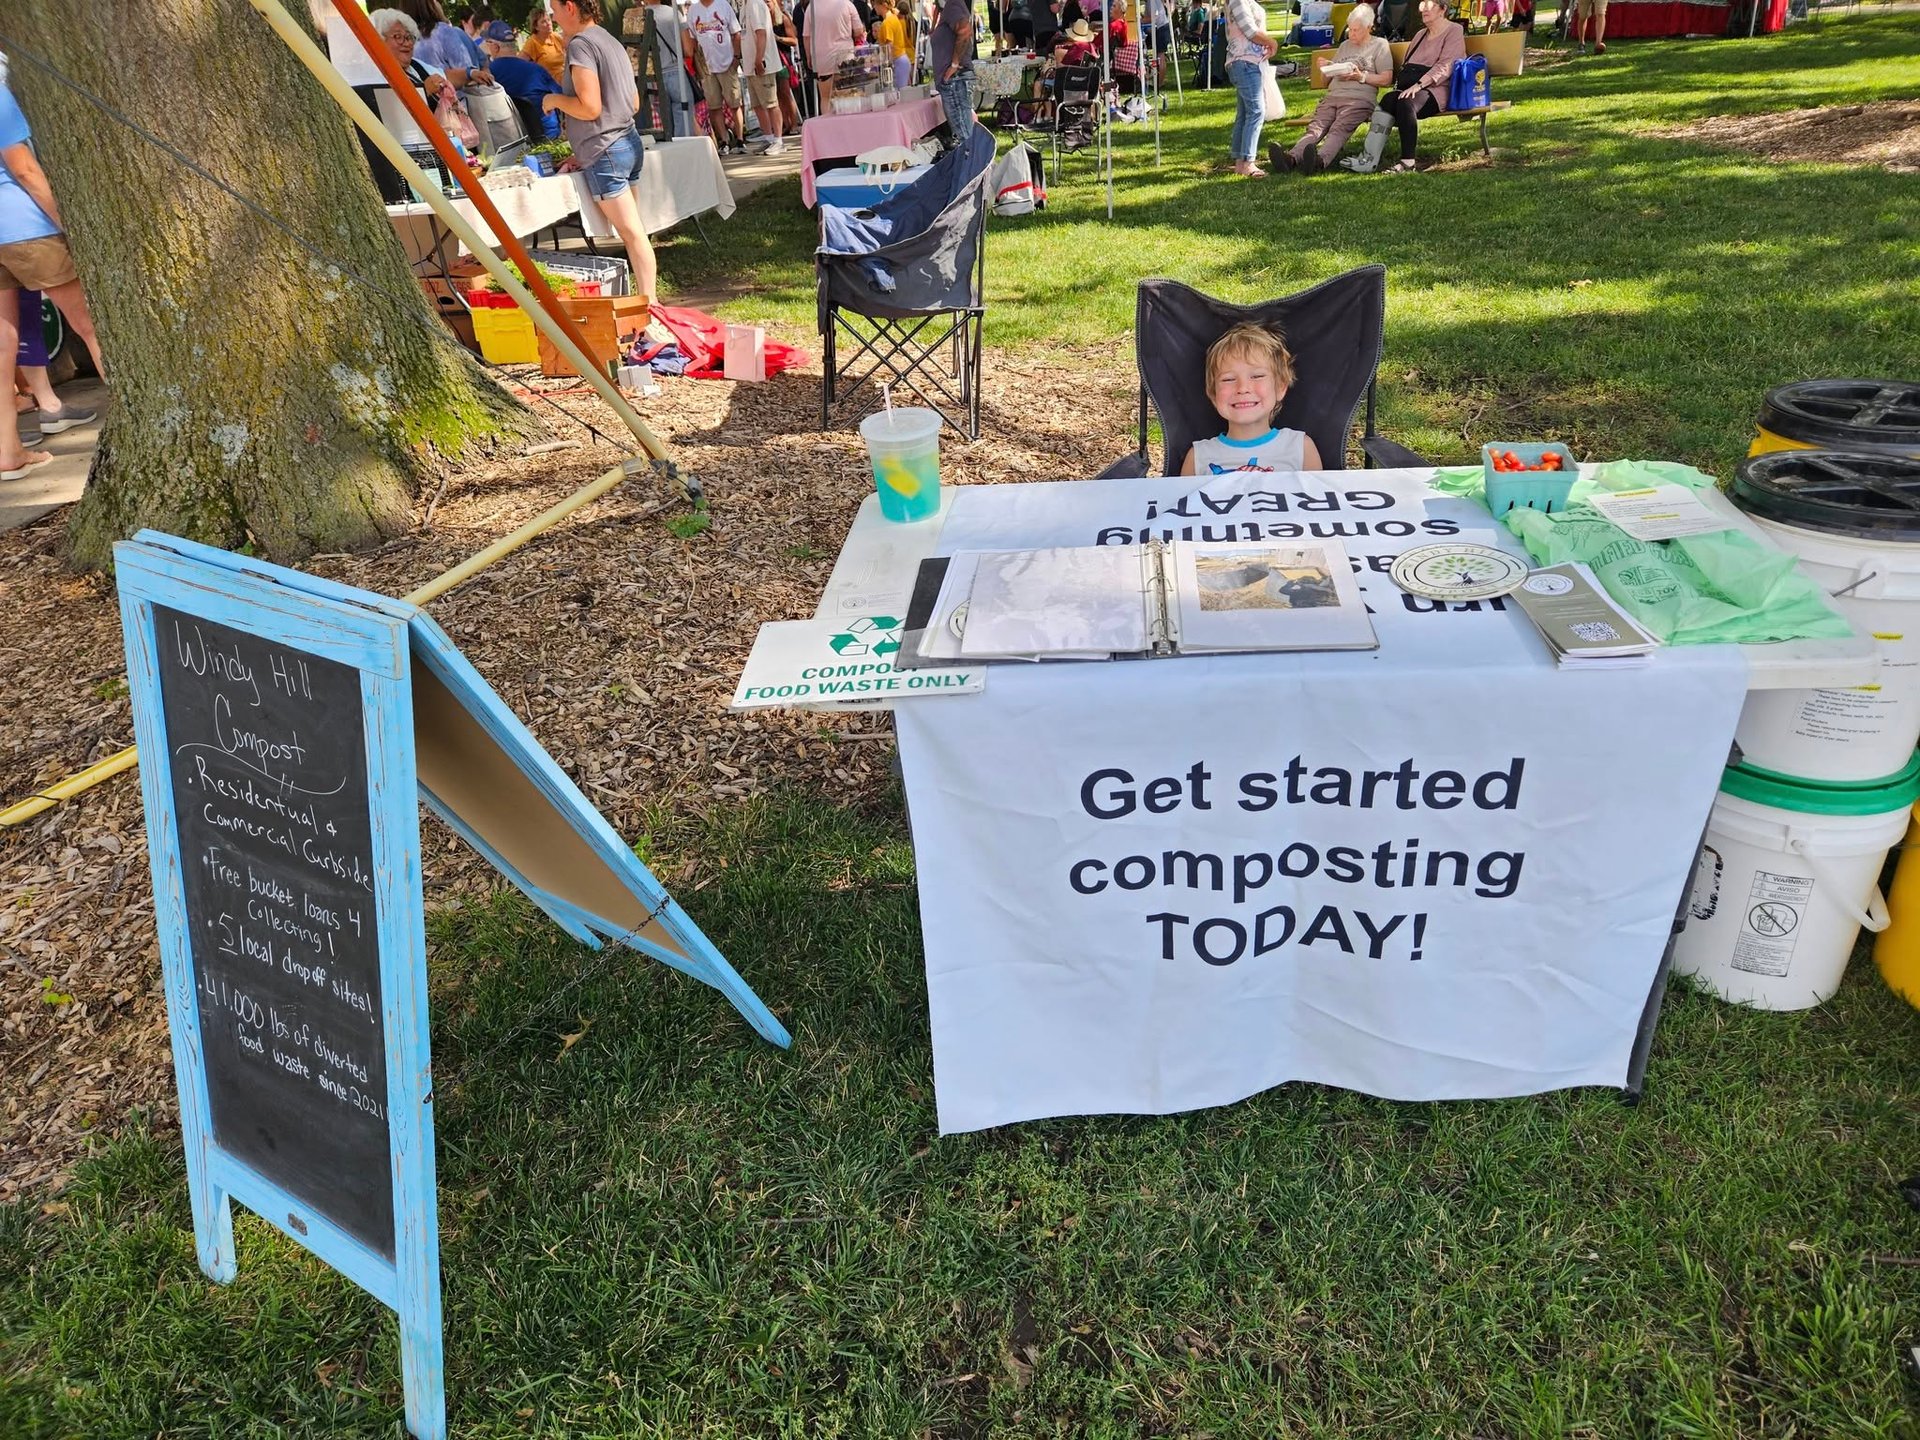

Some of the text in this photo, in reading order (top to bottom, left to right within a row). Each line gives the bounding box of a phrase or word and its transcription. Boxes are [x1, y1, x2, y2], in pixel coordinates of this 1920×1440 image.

[1146, 490, 1396, 520] GREAT!
[175, 621, 312, 706] Windy Hill
[744, 674, 971, 701] FOOD WASTE ONLY
[801, 663, 918, 681] COMPO
[215, 693, 306, 774] Compost
[1080, 754, 1526, 820] Get started
[204, 803, 373, 892] Commercial Curbside
[1069, 838, 1526, 904] composting
[209, 846, 242, 887] Free
[304, 893, 340, 930] loans
[348, 908, 361, 938] 4
[219, 912, 234, 946] 5
[239, 925, 273, 966] local
[332, 978, 375, 1024] sites!
[1146, 904, 1429, 967] TODAY!
[238, 1022, 385, 1120] food waste since 2021
[270, 1006, 290, 1038] lbs
[294, 1024, 310, 1047] of
[314, 1035, 368, 1083] diverted
